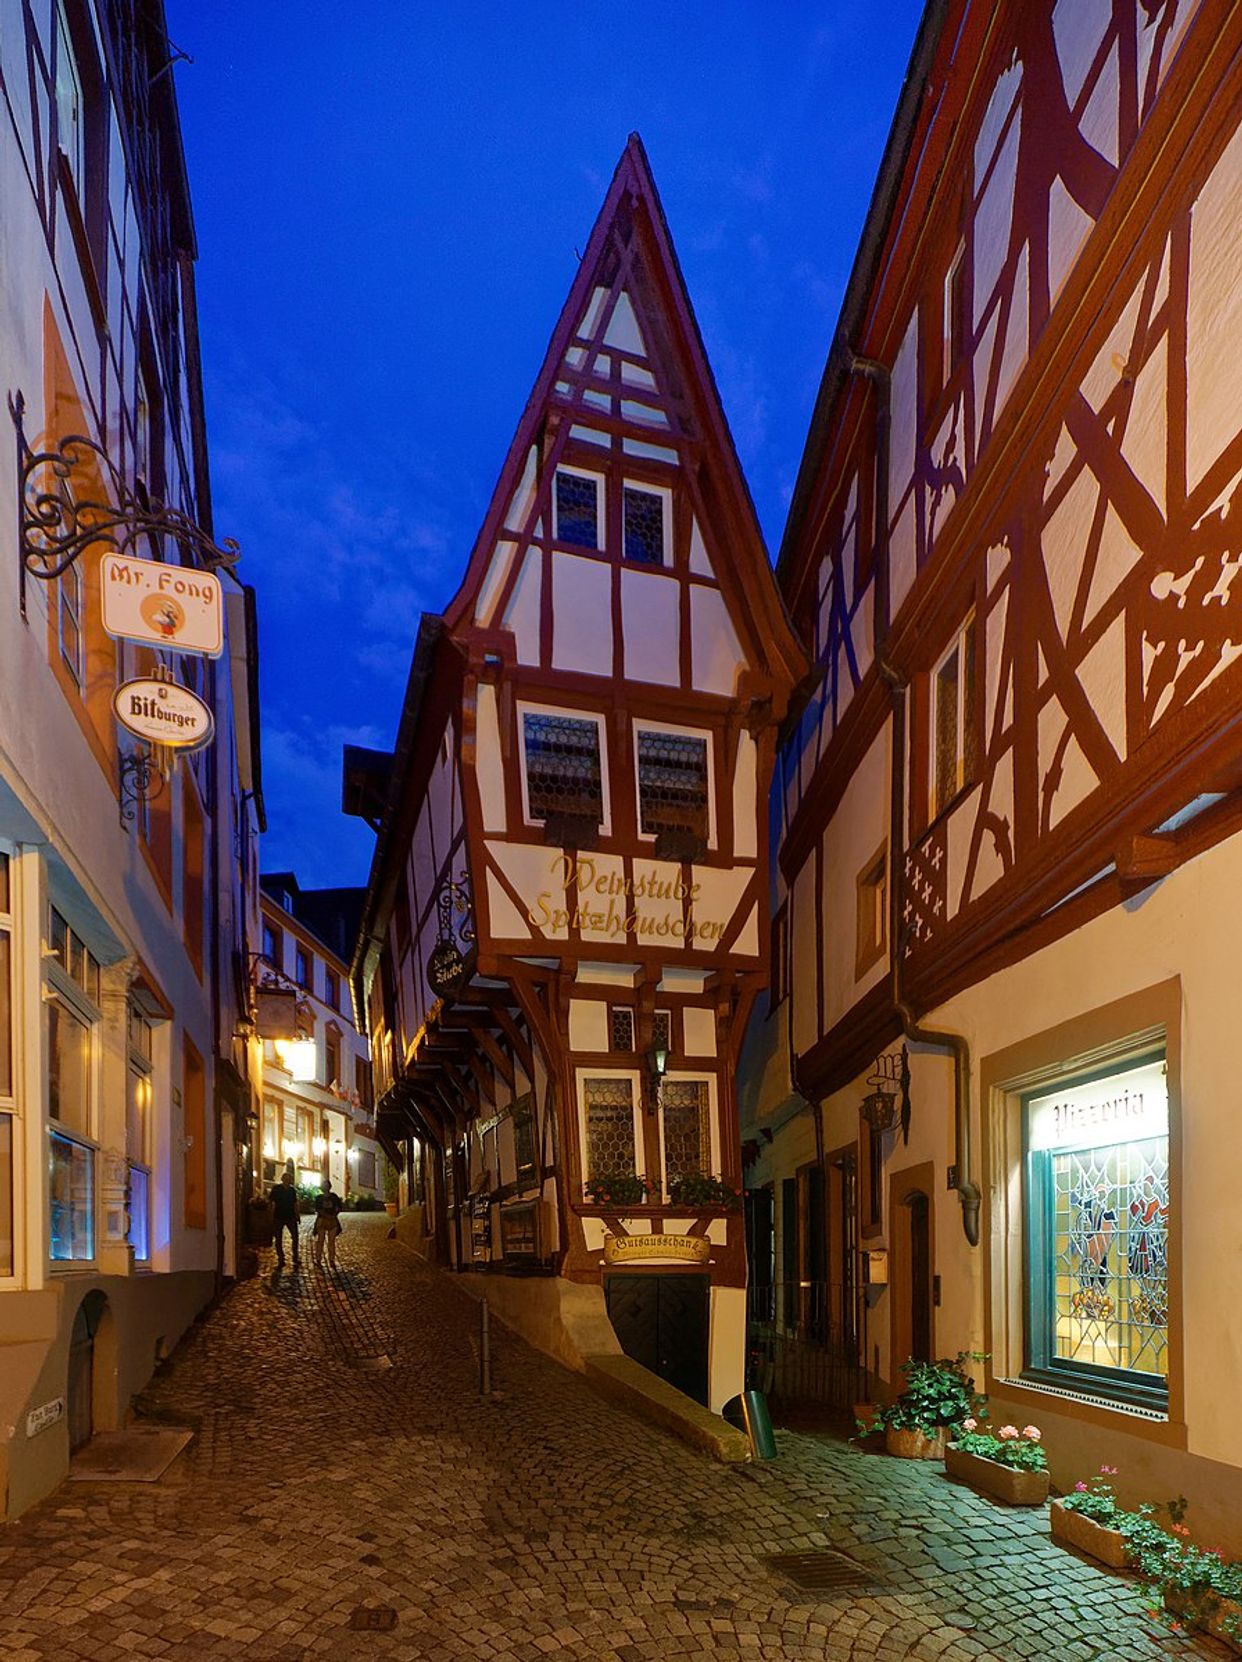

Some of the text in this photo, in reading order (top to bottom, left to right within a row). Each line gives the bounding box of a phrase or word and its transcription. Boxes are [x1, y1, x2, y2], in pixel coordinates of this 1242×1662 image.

[110, 562, 214, 605] Mr. Fong
[129, 694, 198, 728] Bitburger
[550, 854, 702, 902] Weinstube
